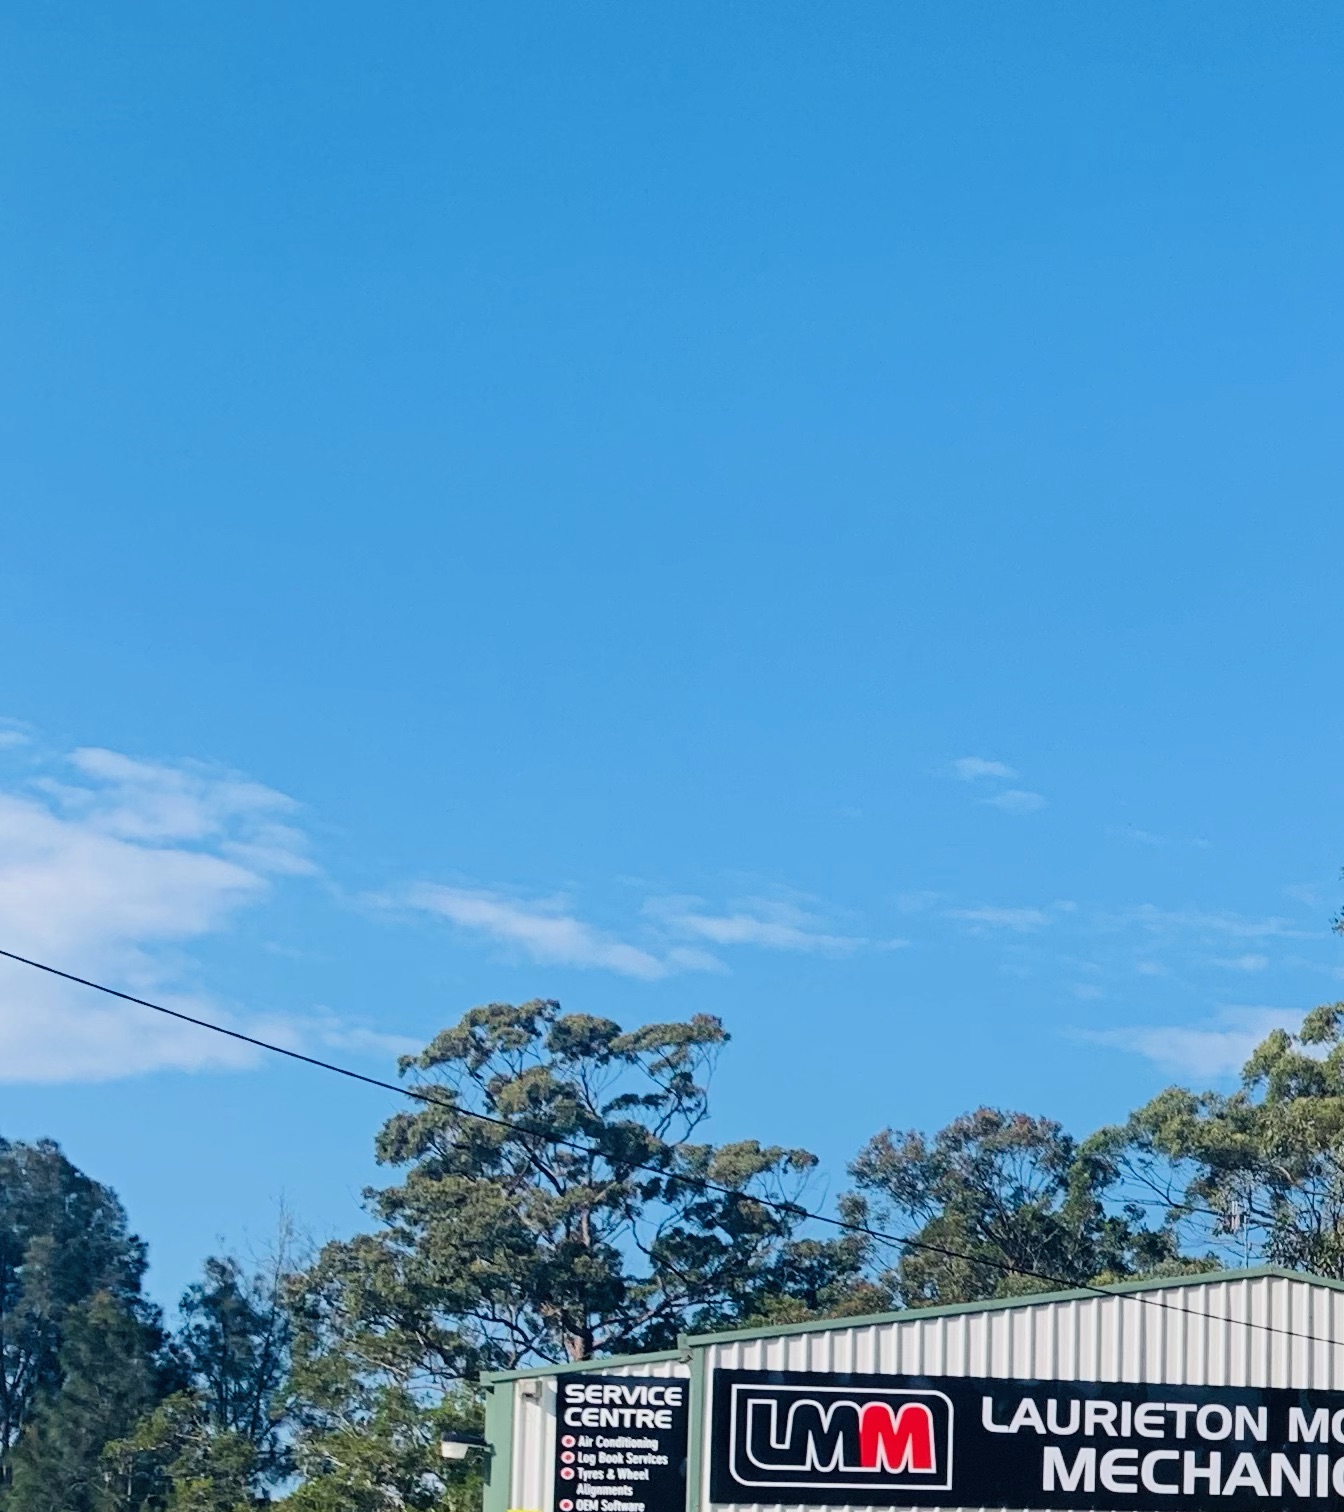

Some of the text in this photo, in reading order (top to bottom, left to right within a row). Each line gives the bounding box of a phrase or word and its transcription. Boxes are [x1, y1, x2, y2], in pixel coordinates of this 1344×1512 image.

[566, 1384, 682, 1406] SERVICE
[564, 1408, 672, 1429] CENTRE
[982, 1397, 1267, 1441] LAURIETON
[578, 1435, 658, 1451] Air Conditioning
[746, 1398, 936, 1473] LMM
[577, 1451, 668, 1466] Log Book Services
[577, 1467, 650, 1481] Tyres & Wheel
[576, 1483, 633, 1498] Alignments
[576, 1499, 645, 1512] OEM Software
